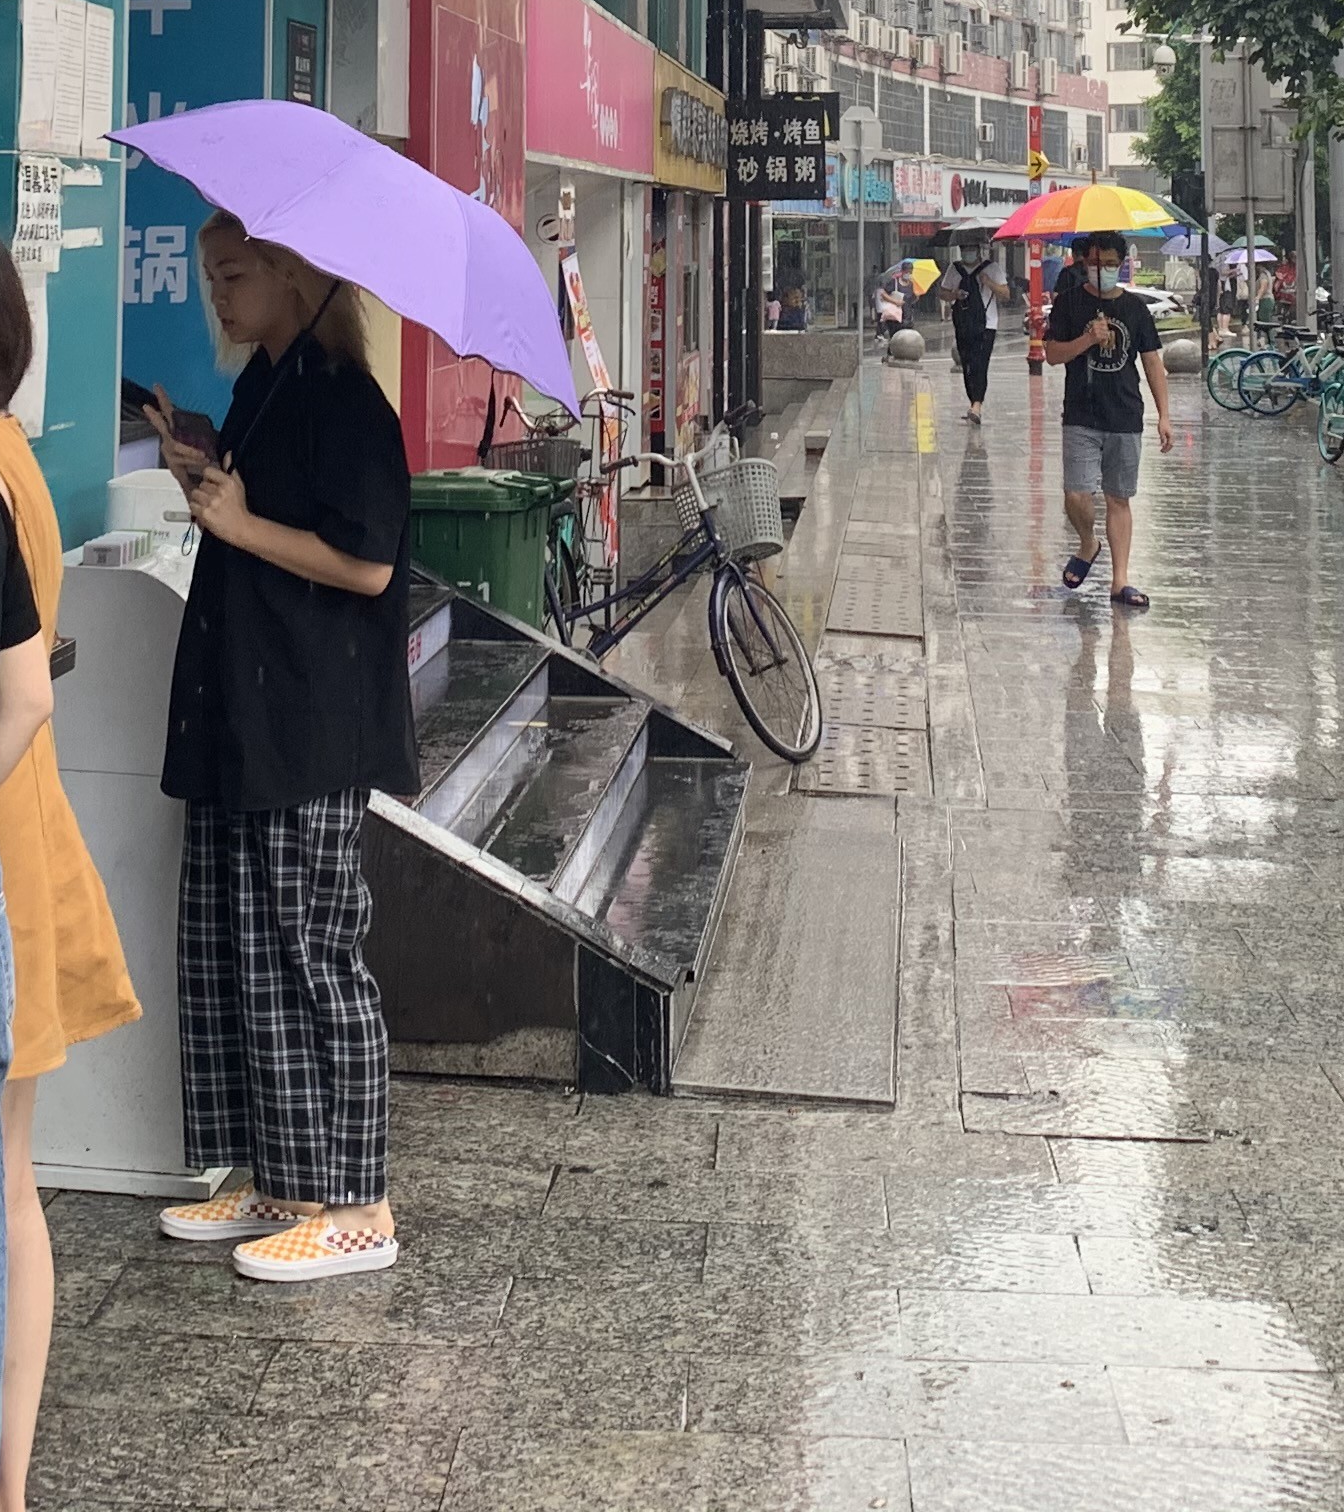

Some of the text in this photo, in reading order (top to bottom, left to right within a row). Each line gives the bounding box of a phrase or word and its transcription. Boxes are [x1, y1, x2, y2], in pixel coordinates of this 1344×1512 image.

[729, 118, 822, 146] 烧烤·烤鱼
[737, 156, 816, 183] 砂锅粥
